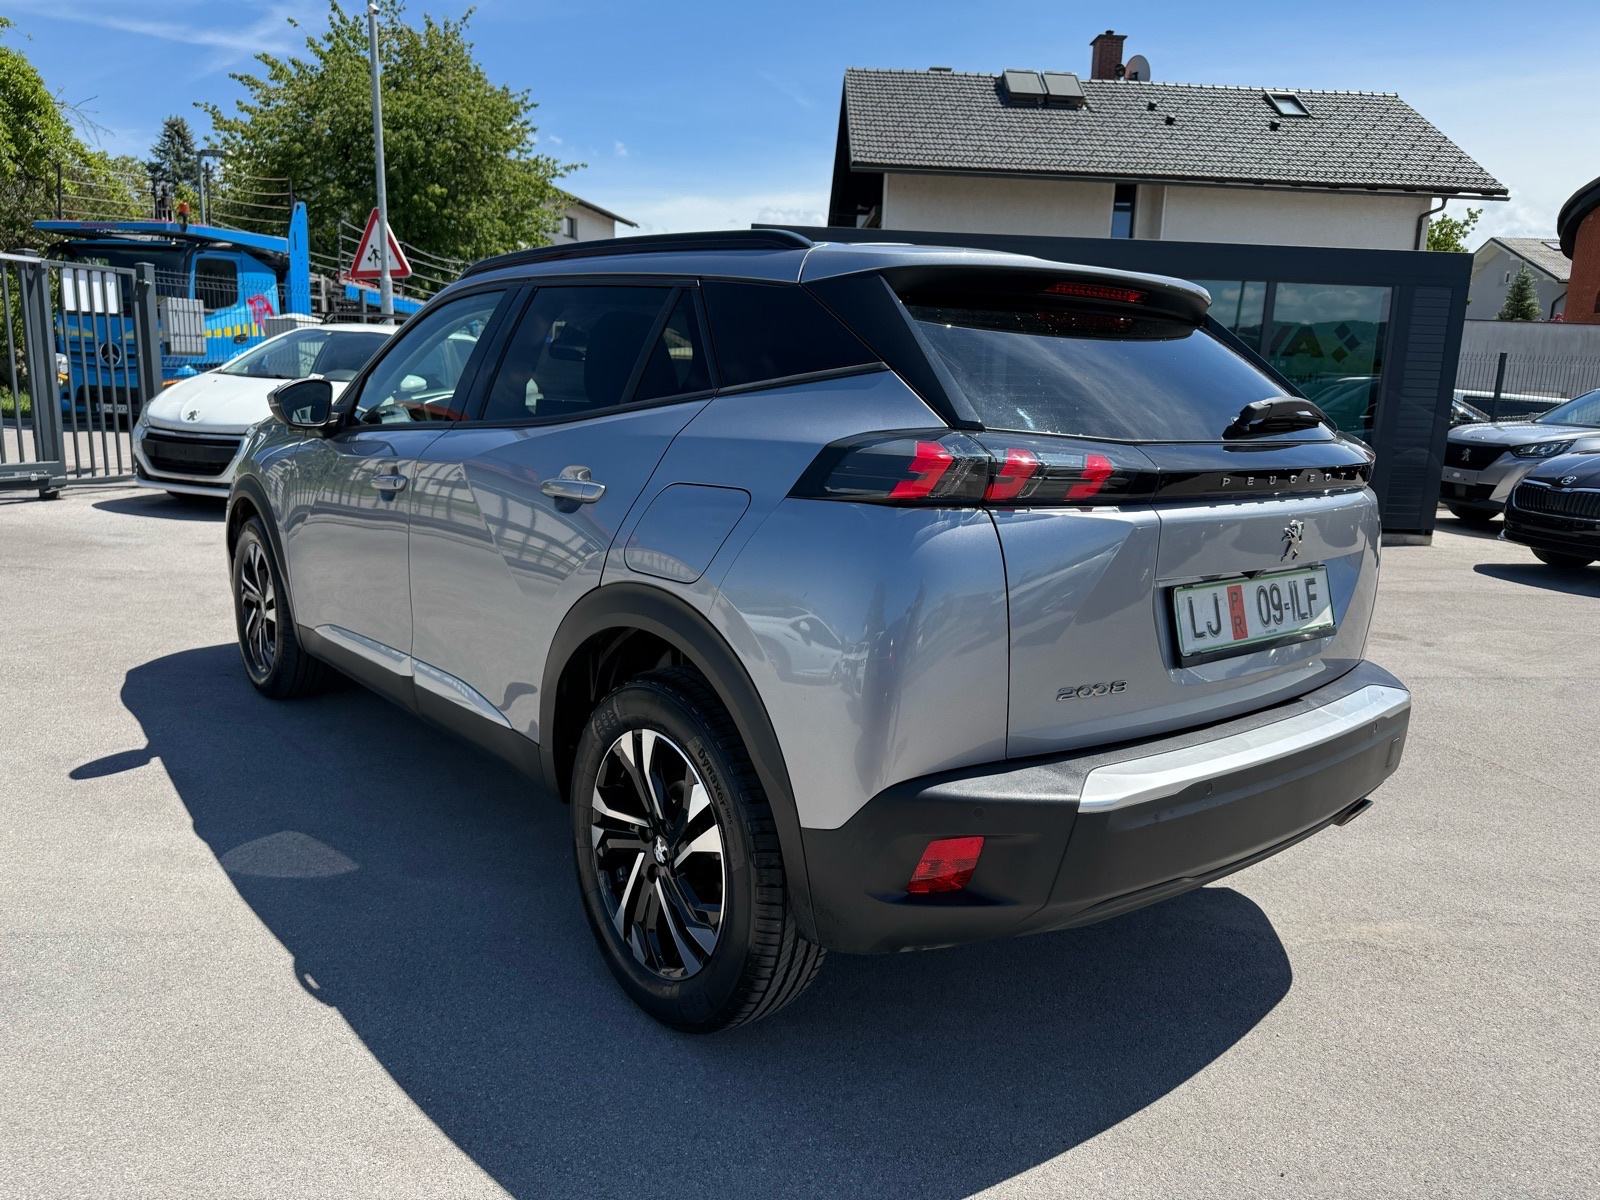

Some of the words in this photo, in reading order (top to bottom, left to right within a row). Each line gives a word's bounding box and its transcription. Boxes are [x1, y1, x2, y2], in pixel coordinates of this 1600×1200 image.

[1221, 471, 1347, 487] PEUGEOT
[1187, 592, 1222, 640] LJ
[1055, 679, 1128, 702] 2008
